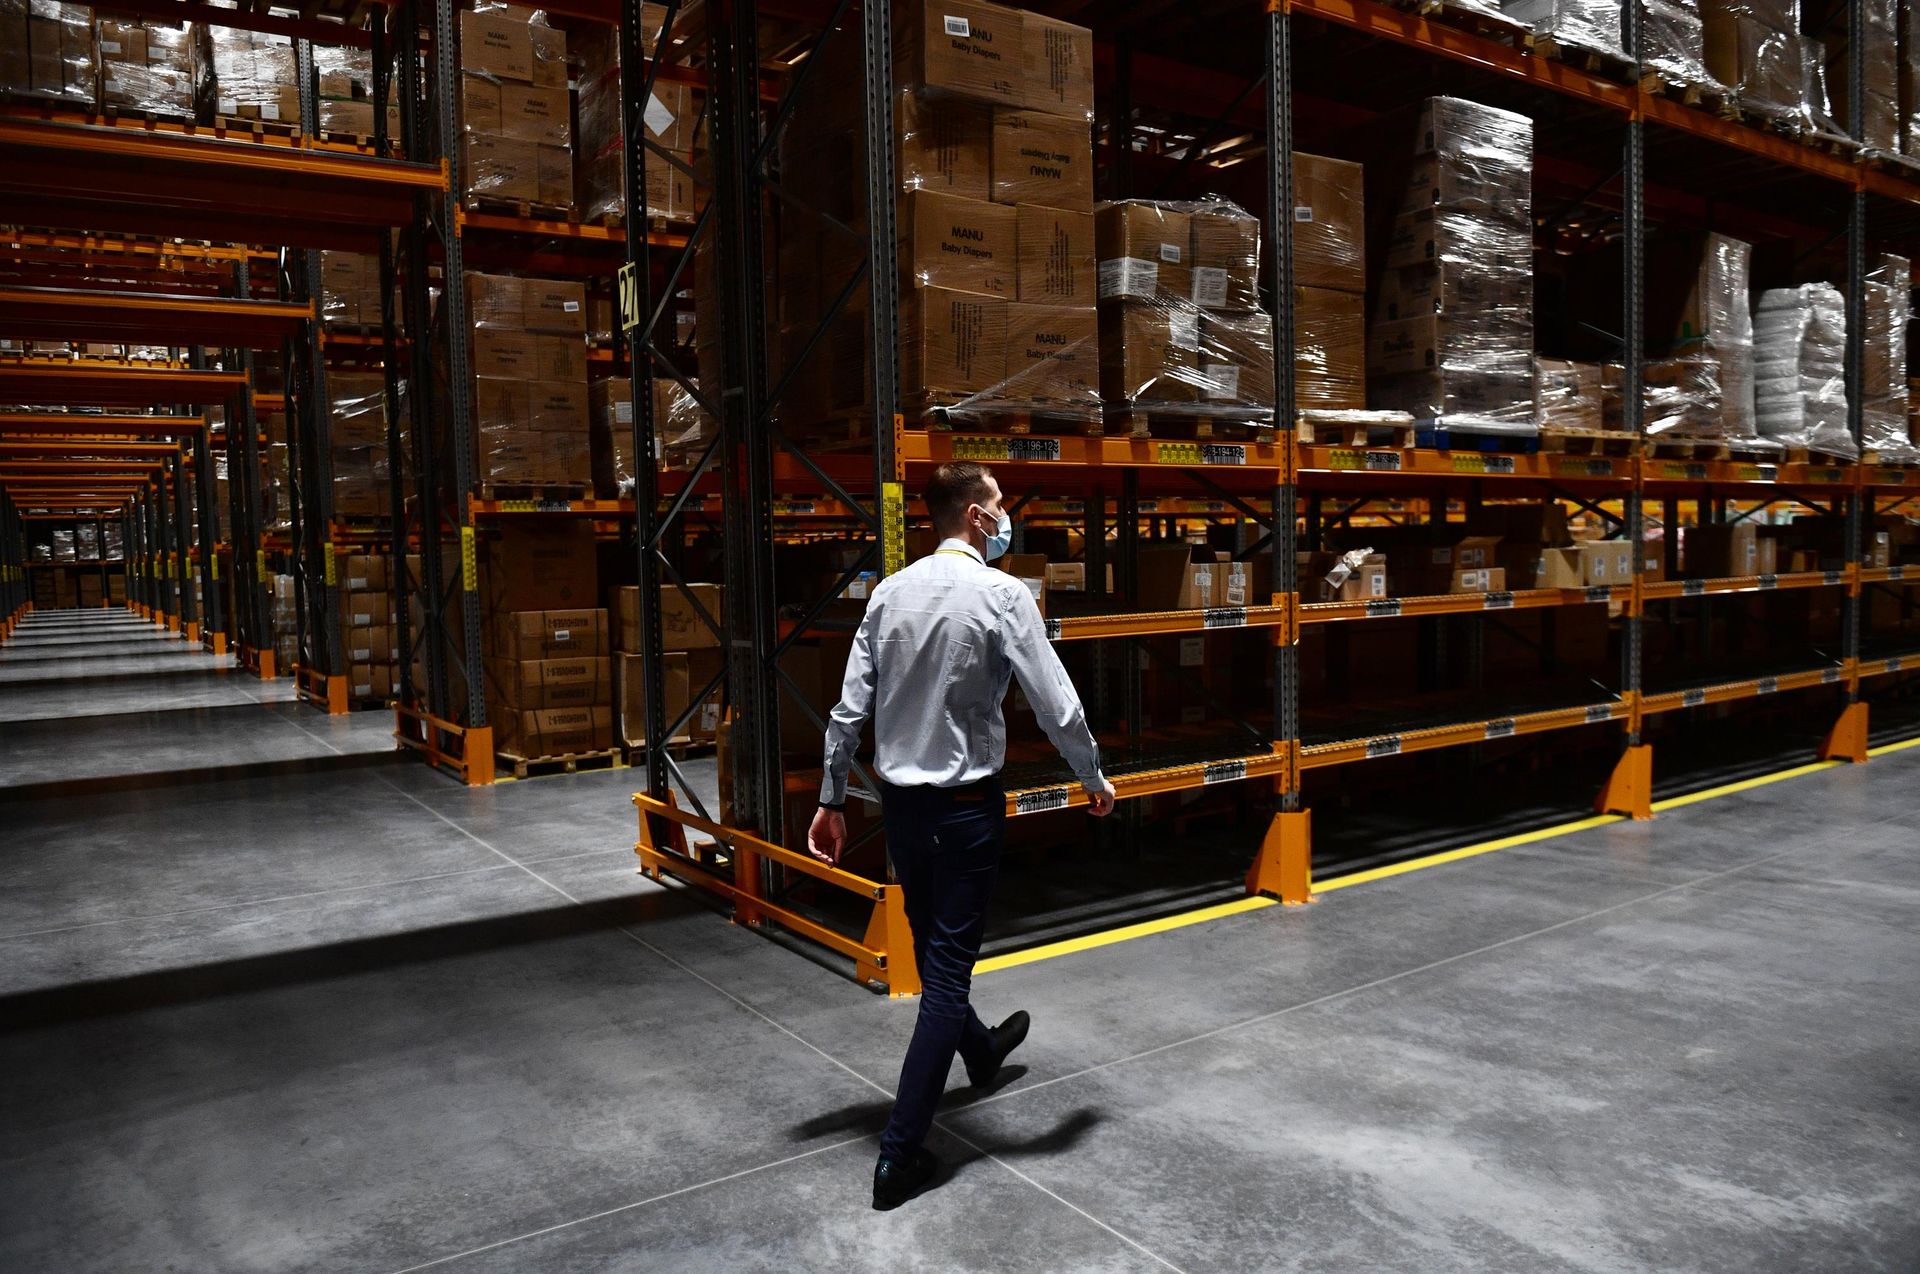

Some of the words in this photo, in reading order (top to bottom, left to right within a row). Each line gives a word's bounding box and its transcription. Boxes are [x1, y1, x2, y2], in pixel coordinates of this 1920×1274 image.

[965, 27, 993, 42] ANU
[951, 39, 970, 54] Baby
[973, 44, 1001, 61] Diapers
[1020, 148, 1049, 161] Diapers
[1051, 151, 1071, 164] Baby
[1030, 165, 1061, 179] MANU
[951, 225, 984, 242] MANU
[941, 242, 961, 255] Baby
[962, 246, 993, 259] Diapers
[620, 266, 636, 325] 27
[1035, 333, 1066, 345] MANU
[1026, 349, 1046, 360] Baby
[1013, 440, 1054, 452] 28-196-12
